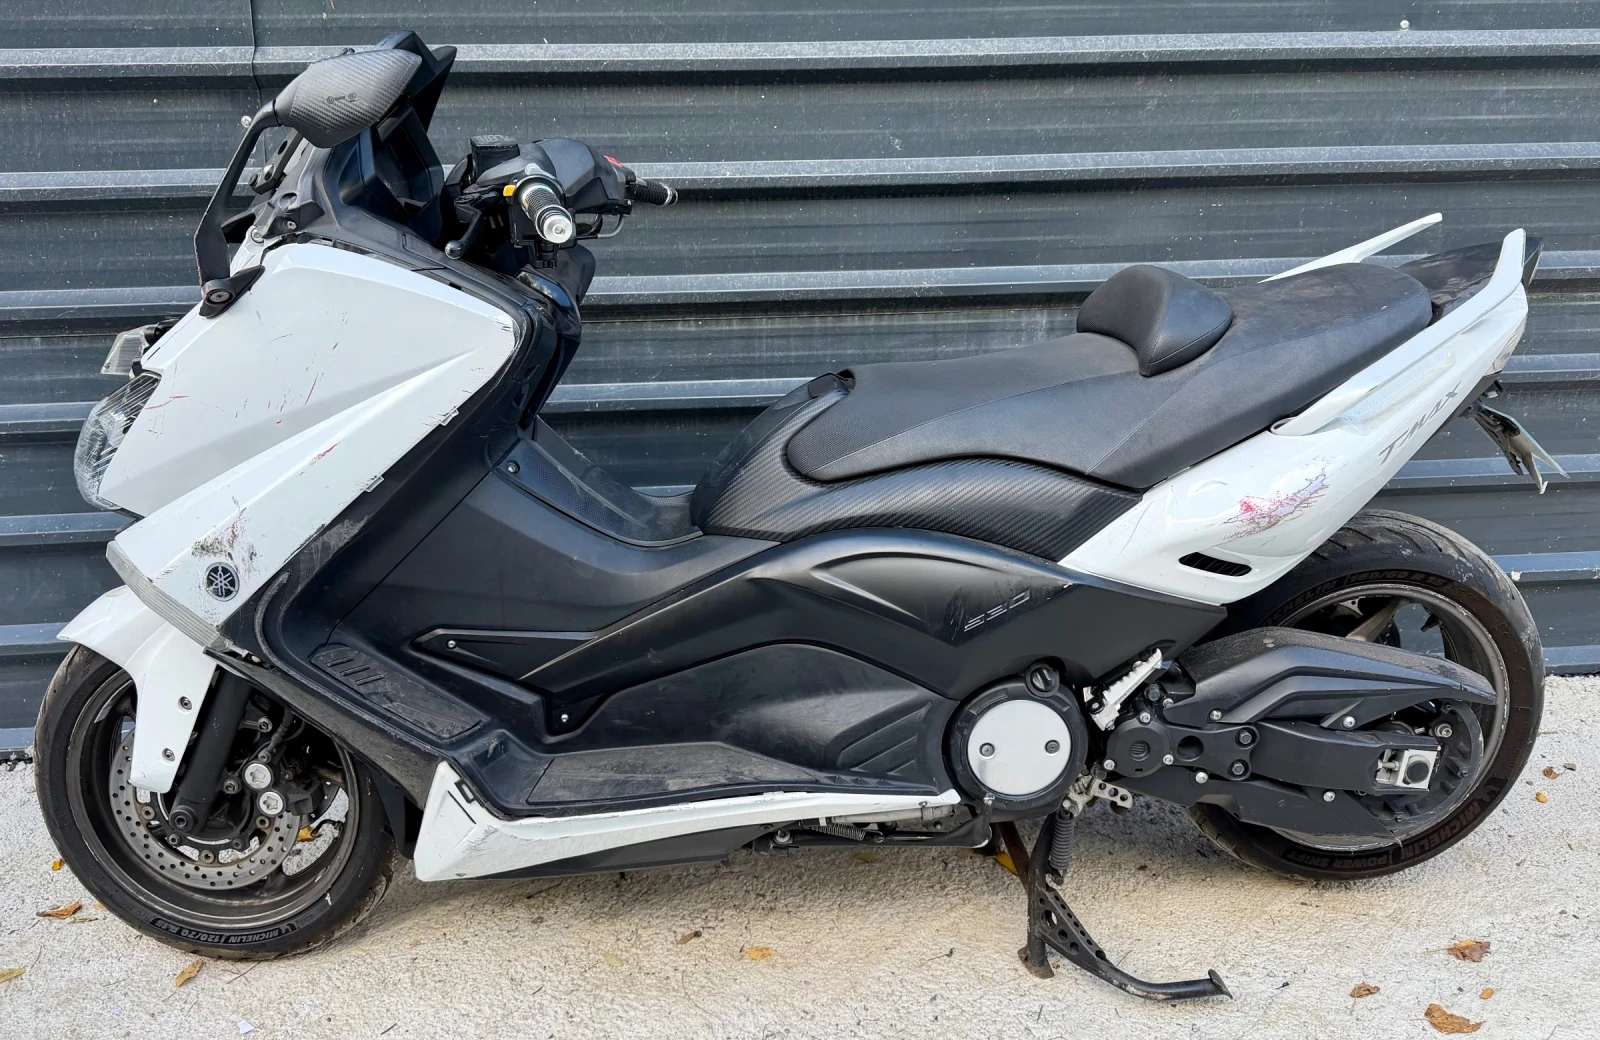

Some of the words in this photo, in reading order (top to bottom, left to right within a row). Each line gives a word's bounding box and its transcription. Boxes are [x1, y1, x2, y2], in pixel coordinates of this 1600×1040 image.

[1400, 800, 1481, 860] MICHELIN
[1333, 854, 1387, 869] POWER
[181, 929, 220, 943] 120/70
[228, 929, 279, 943] MICHELIN
